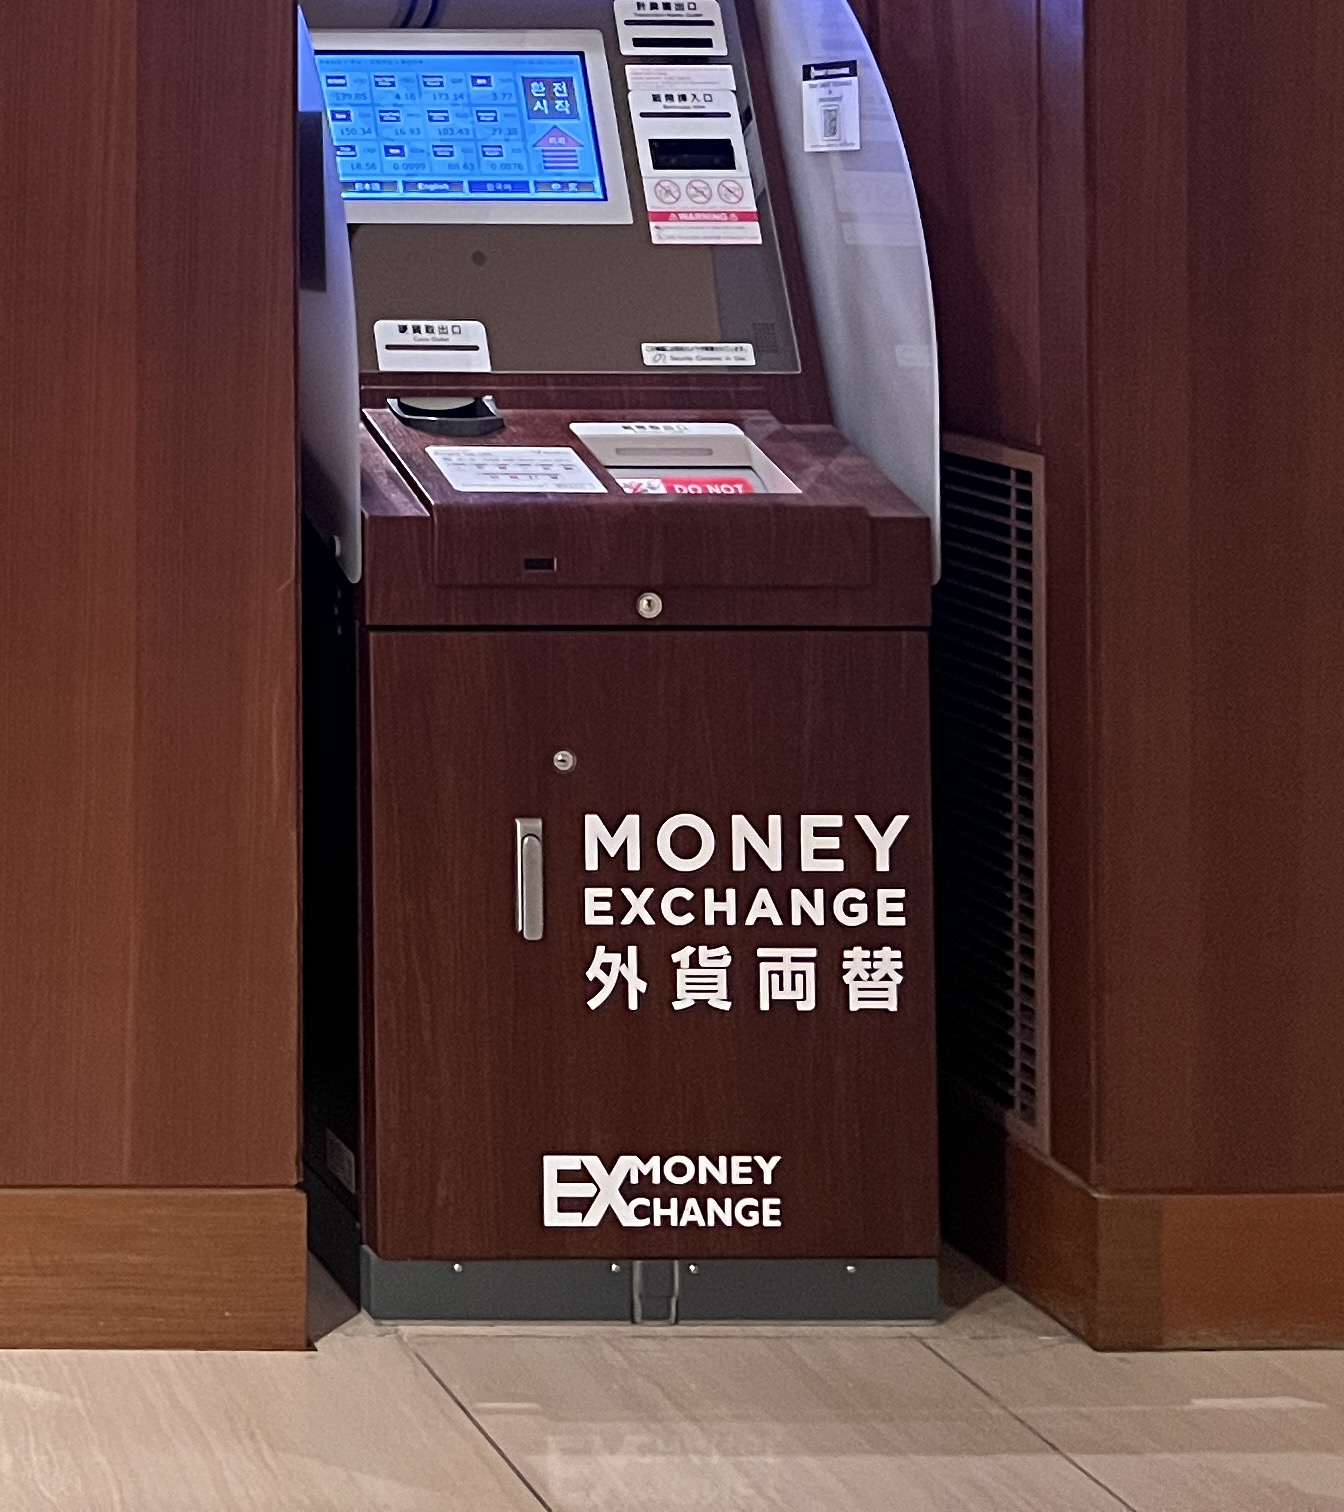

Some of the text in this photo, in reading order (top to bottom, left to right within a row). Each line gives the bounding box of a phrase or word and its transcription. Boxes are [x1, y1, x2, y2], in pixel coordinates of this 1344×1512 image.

[583, 813, 910, 872] MONEY
[583, 888, 907, 927] EXCHANGE
[585, 945, 904, 1013] 外貨両替
[542, 1155, 782, 1227] EX MONEY
[627, 1197, 782, 1228] CHANGE
